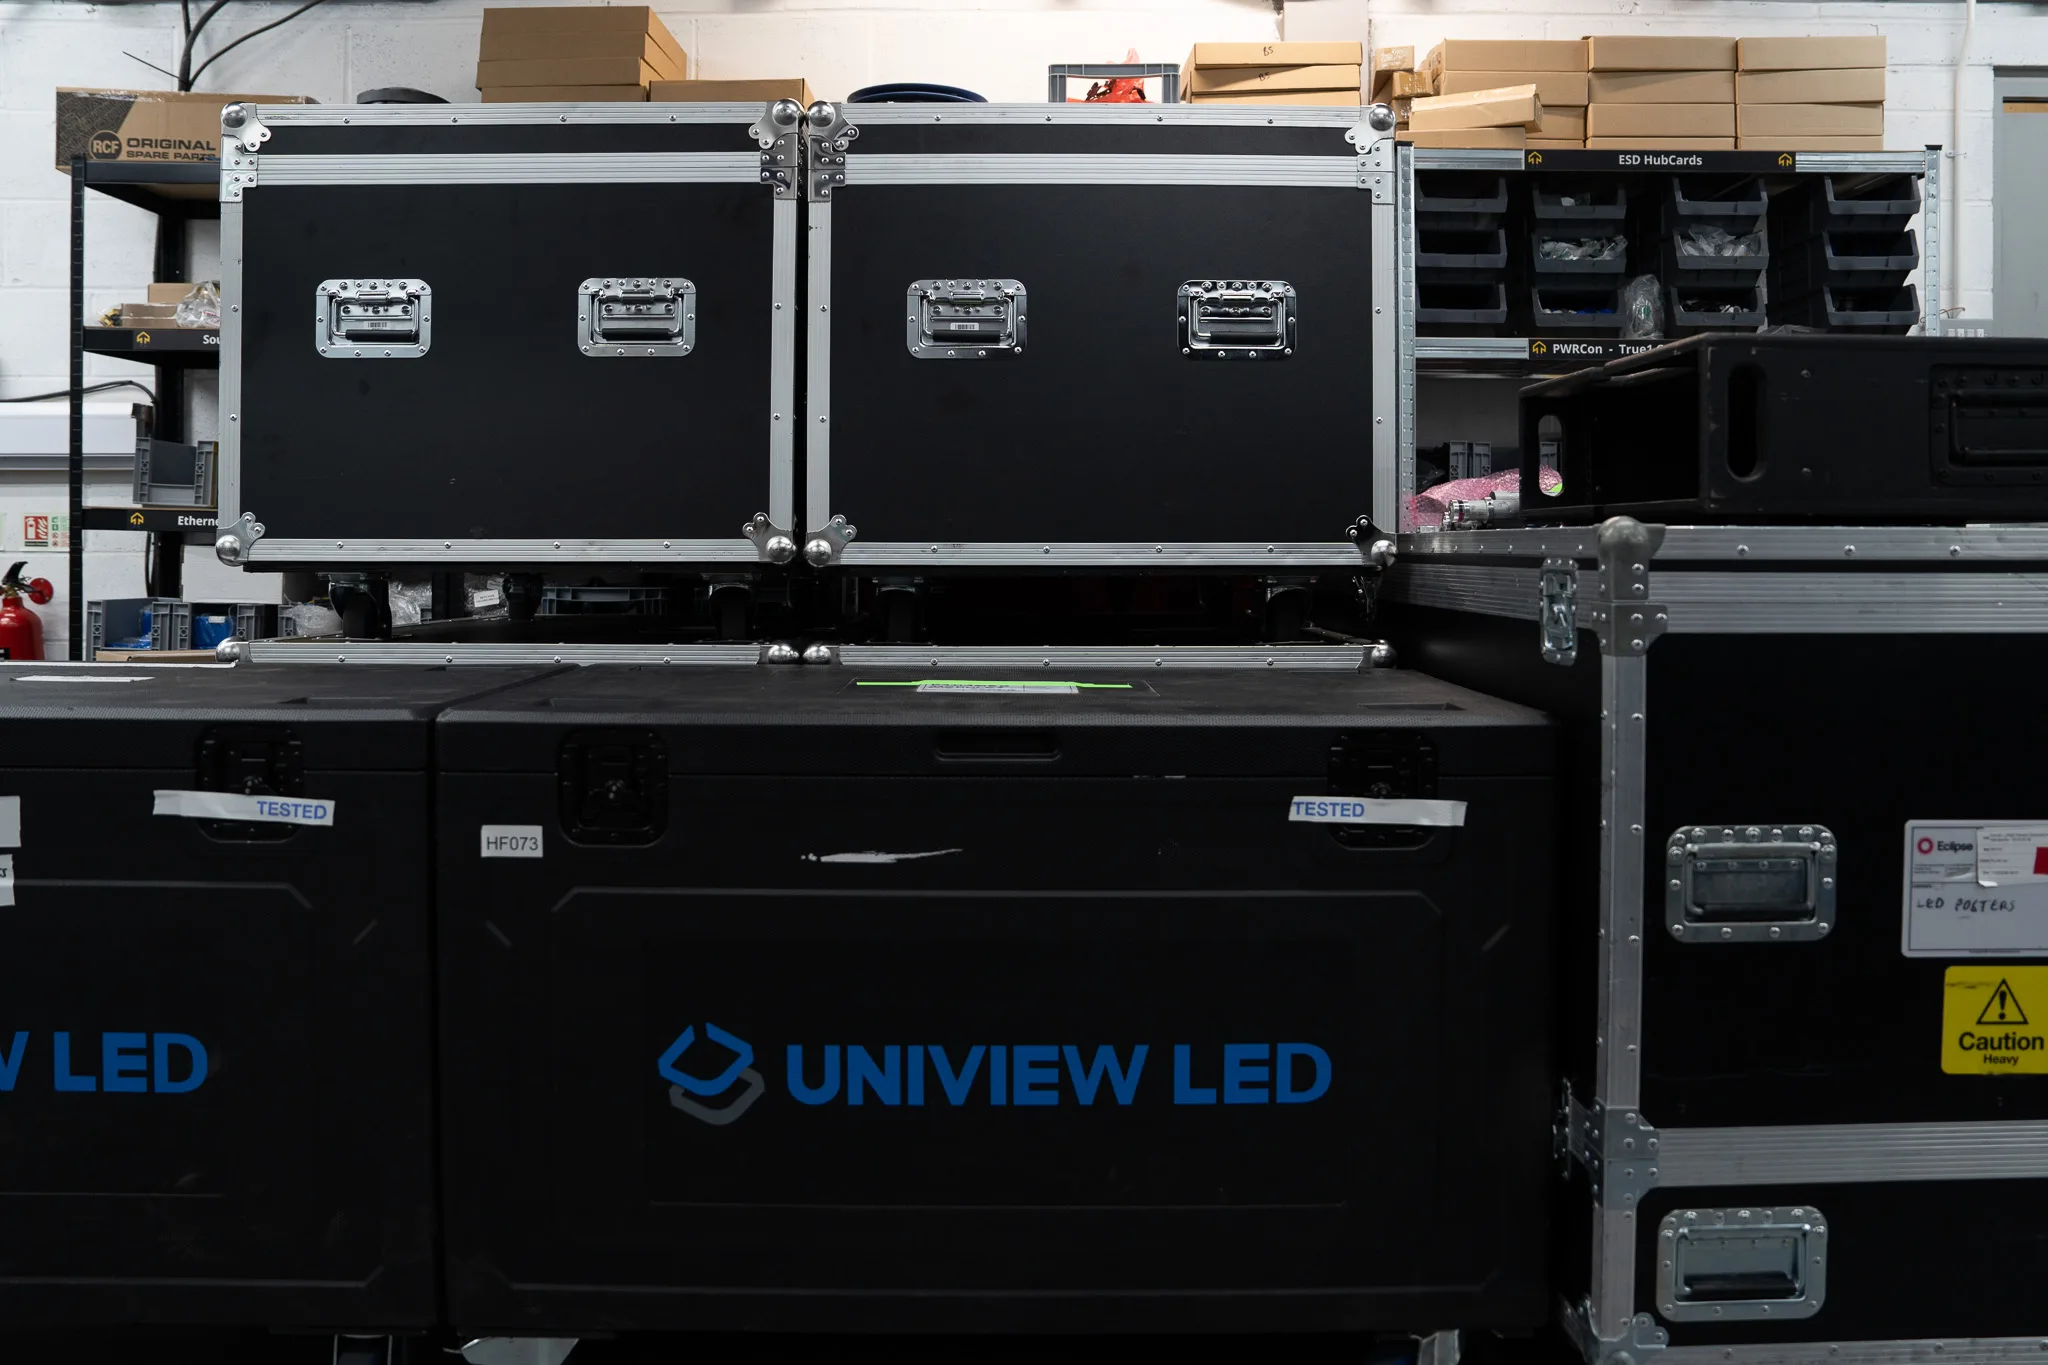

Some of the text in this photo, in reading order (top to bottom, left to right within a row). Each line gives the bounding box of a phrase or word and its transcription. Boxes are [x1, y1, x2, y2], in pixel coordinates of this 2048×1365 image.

[93, 140, 120, 154] RCF
[126, 138, 217, 151] ORIGINAL
[126, 150, 169, 160] SPARE
[1618, 154, 1703, 166] ESD HubCards
[1552, 343, 1603, 354] PWRCon
[257, 800, 328, 820] TESTED
[1293, 801, 1365, 818] TESTED
[486, 836, 539, 851] HF073
[1937, 840, 1974, 855] Eclipse
[1916, 897, 1945, 909] LED
[1958, 1031, 2045, 1051] Caution
[53, 1031, 208, 1093] LED
[1983, 1053, 2020, 1067] Heavy
[786, 1042, 1332, 1106] UNIVIEW LED
